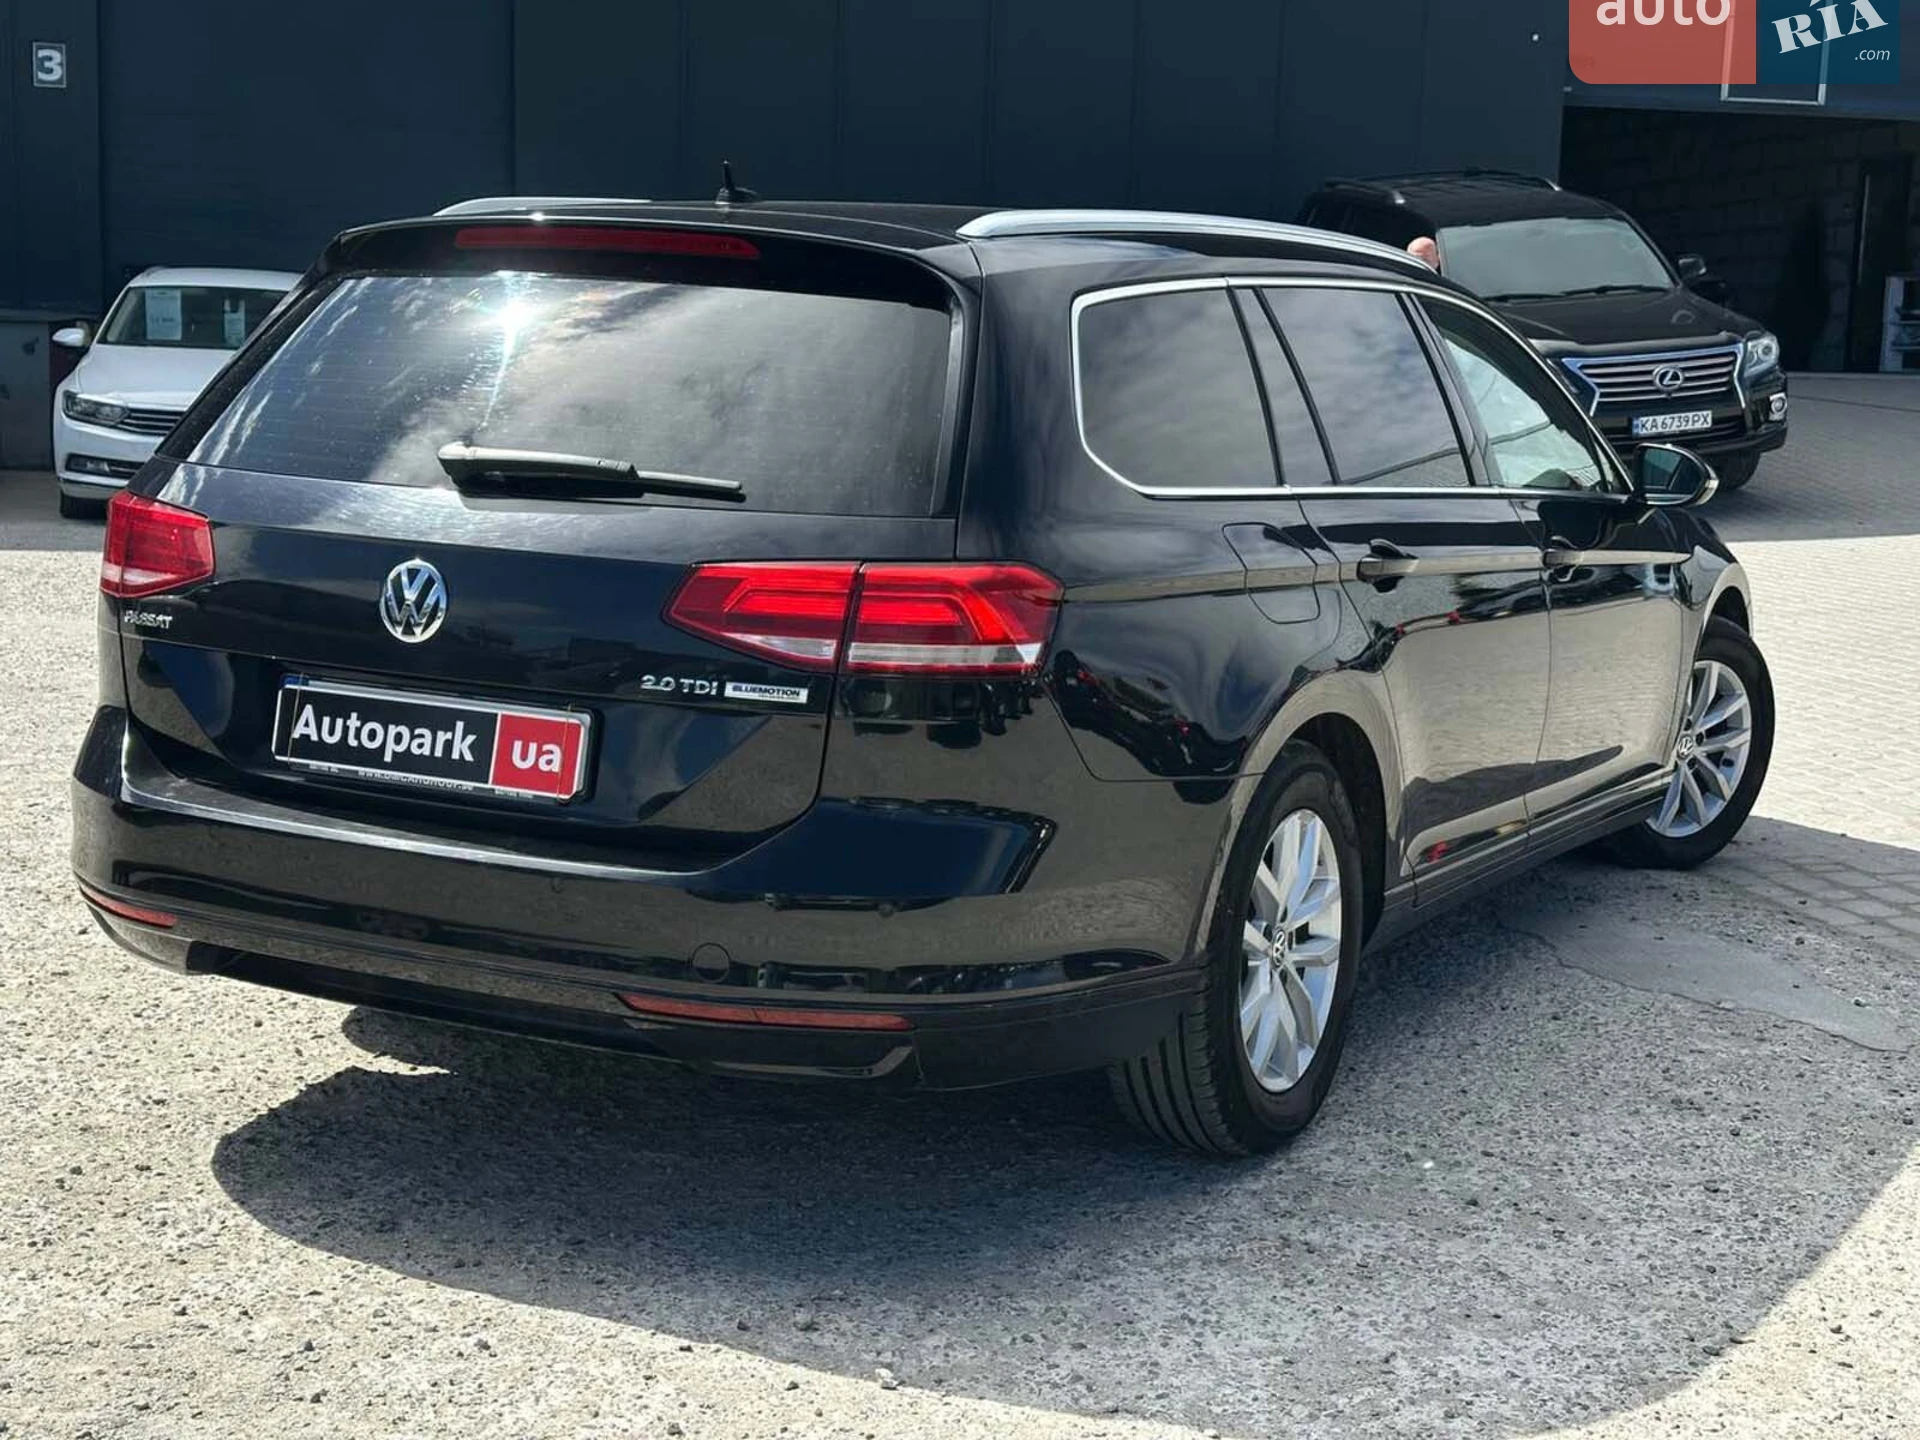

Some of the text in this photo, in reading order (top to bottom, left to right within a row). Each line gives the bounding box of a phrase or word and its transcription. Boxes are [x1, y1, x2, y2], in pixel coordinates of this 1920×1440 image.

[37, 49, 62, 81] 3
[124, 610, 173, 629] PASSAT
[679, 678, 718, 696] TDI
[732, 684, 800, 697] BLUEMOTION
[291, 703, 563, 773] Autopark ua
